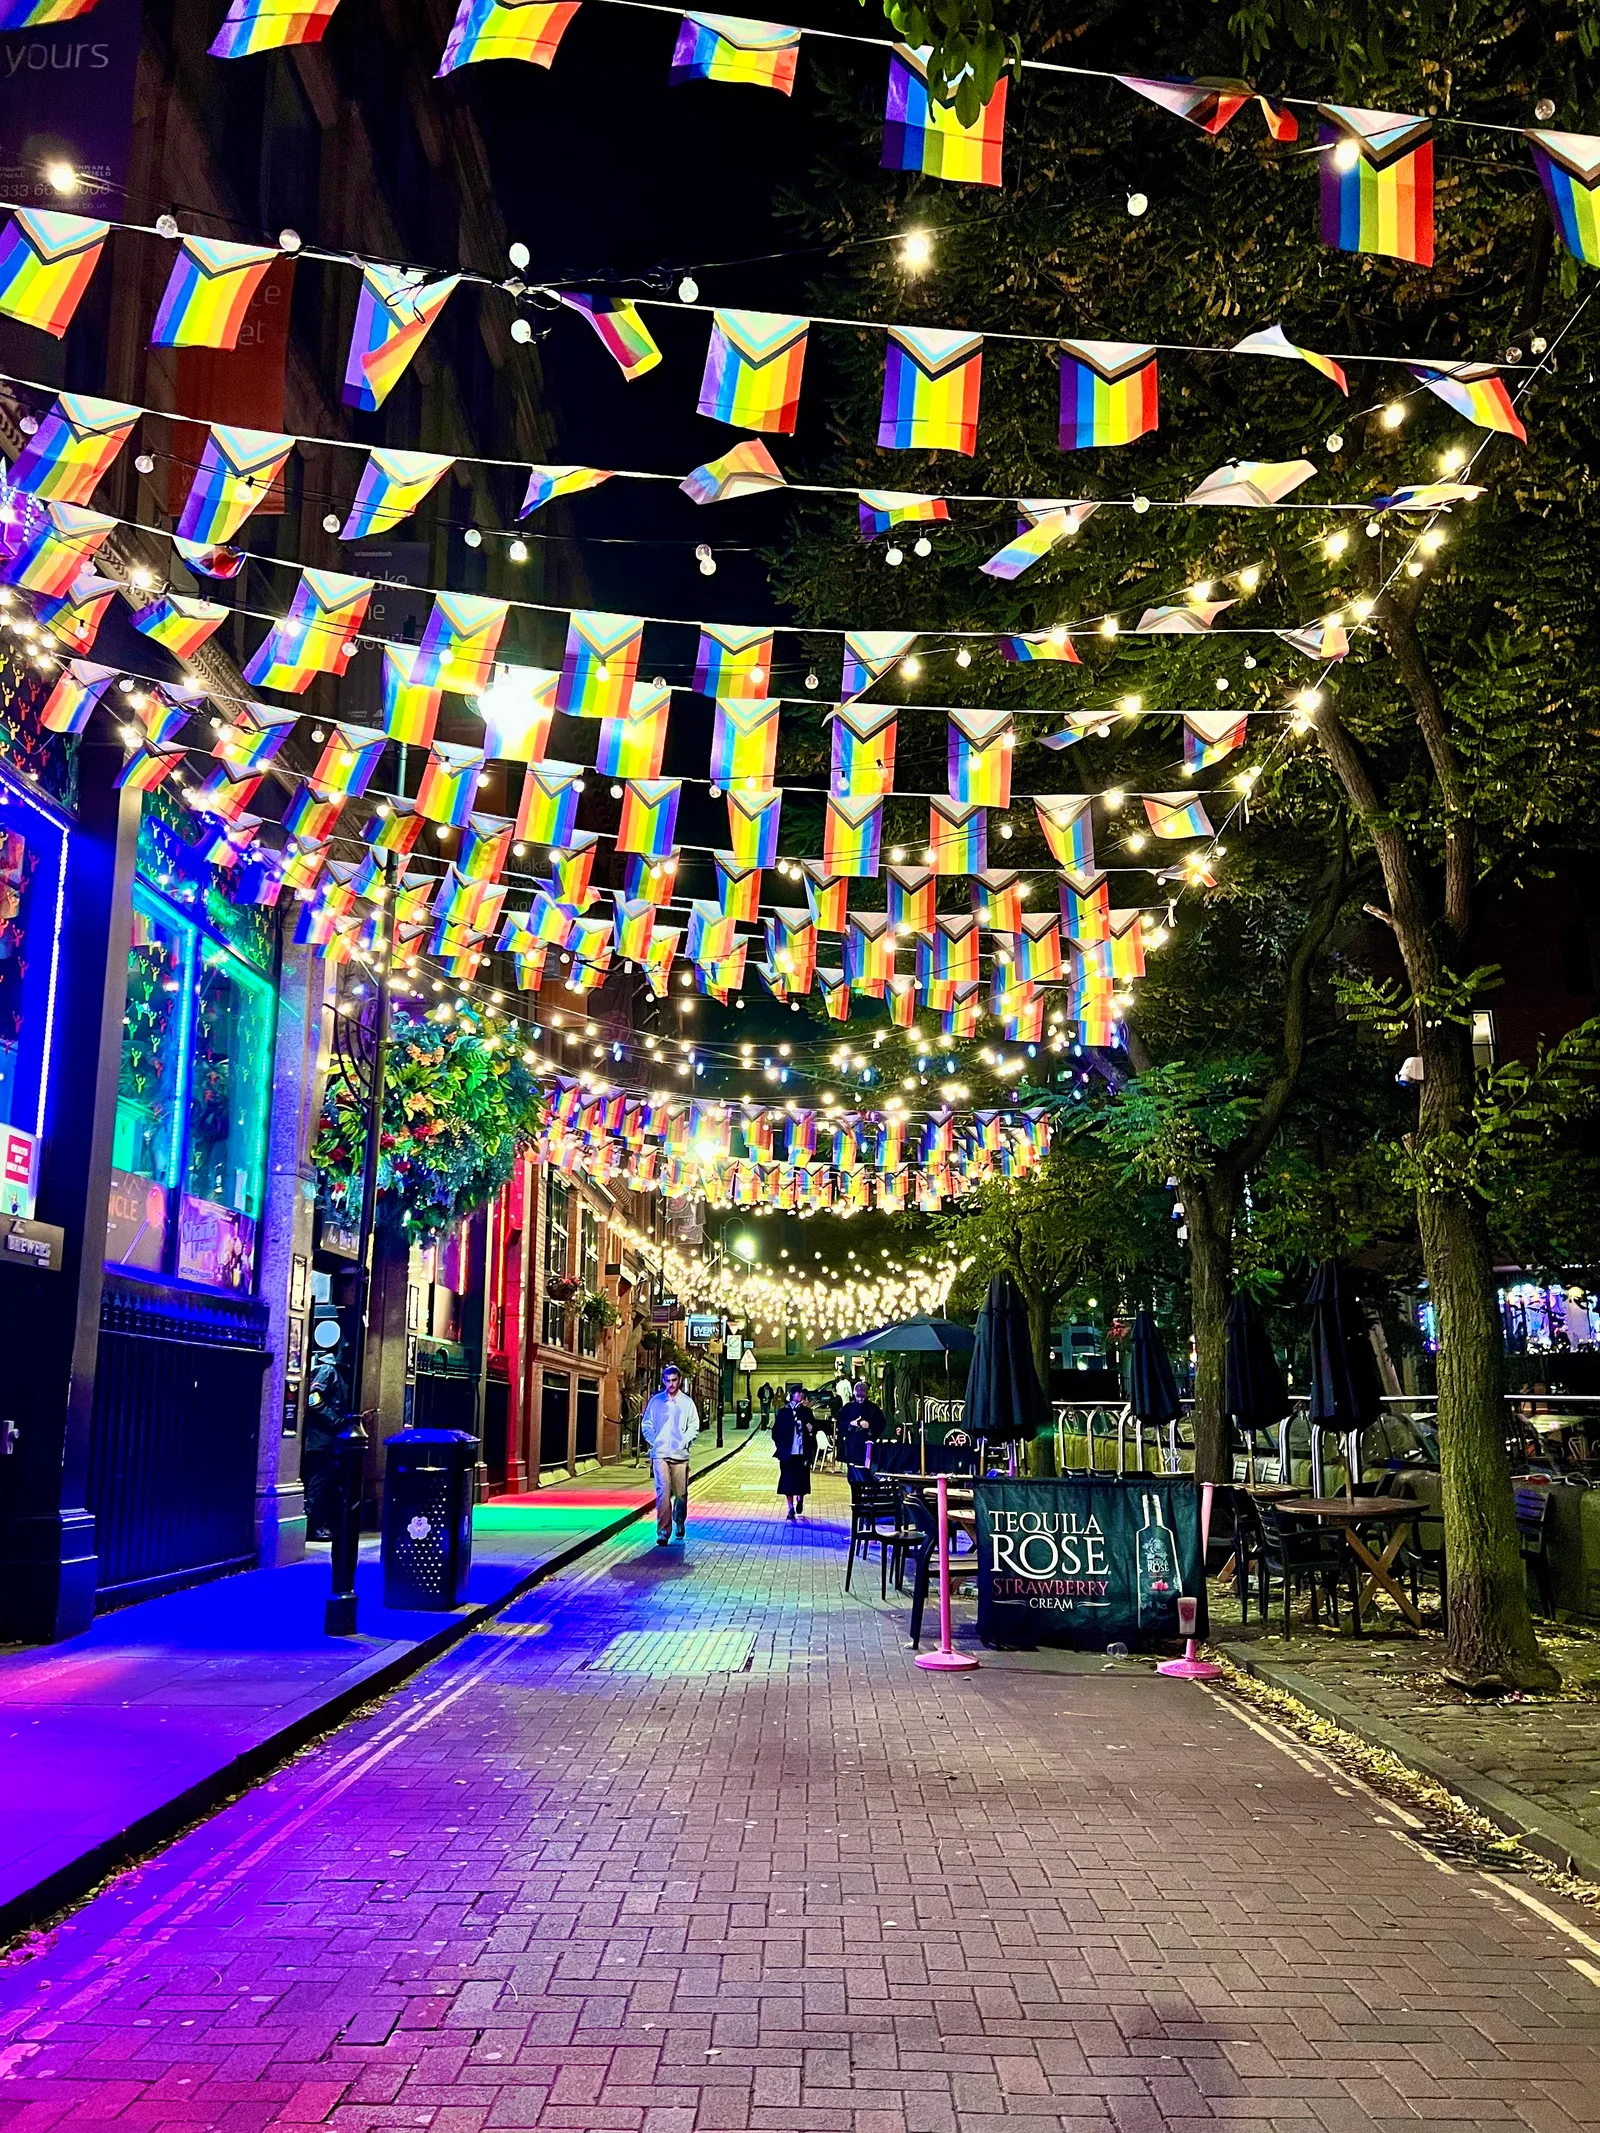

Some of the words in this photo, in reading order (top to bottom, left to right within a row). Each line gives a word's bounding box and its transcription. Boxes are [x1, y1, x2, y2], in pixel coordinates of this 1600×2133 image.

[4, 43, 110, 78] yours
[7, 1234, 52, 1259] BREWERS
[989, 1510, 1104, 1536] TEQUILA
[990, 1533, 1110, 1580] ROSE
[1147, 1563, 1171, 1573] ROSE
[992, 1578, 1110, 1597] STRAWBERRY
[1029, 1597, 1074, 1612] CREAM
